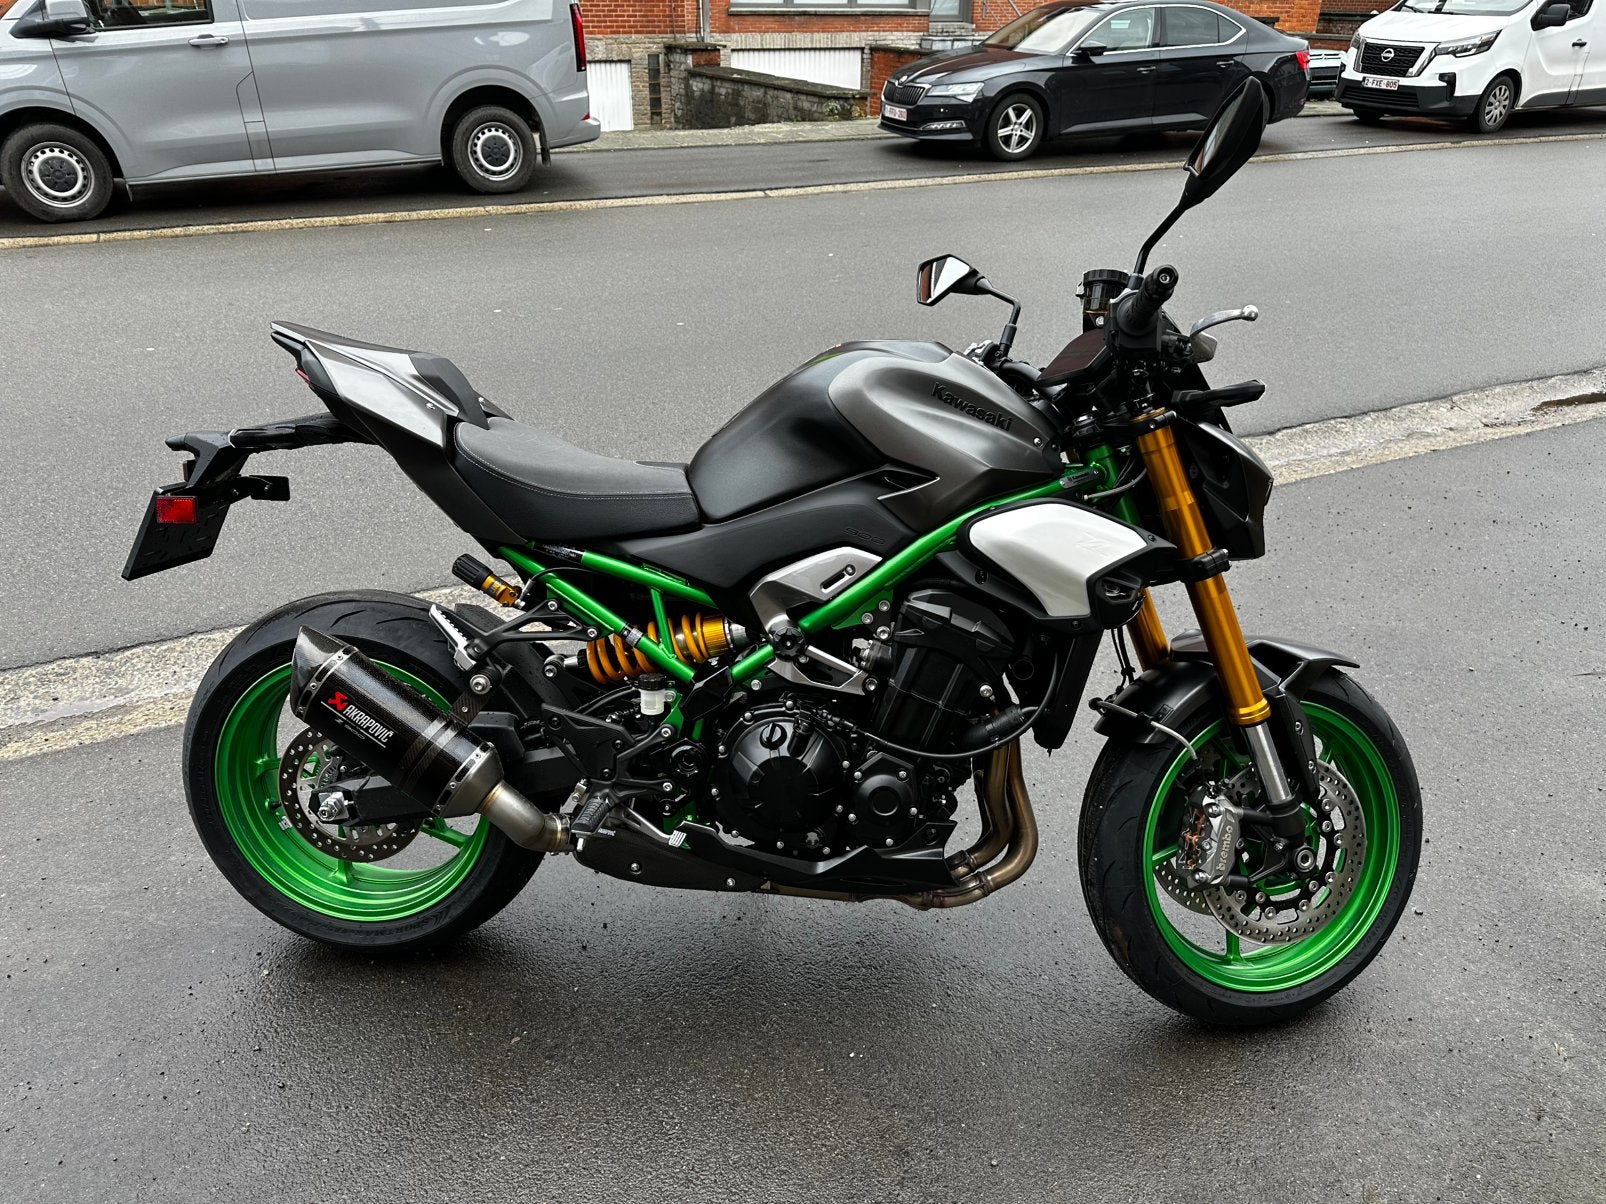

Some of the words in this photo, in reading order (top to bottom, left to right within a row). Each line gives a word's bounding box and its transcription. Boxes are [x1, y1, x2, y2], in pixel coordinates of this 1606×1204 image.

[931, 381, 1013, 432] Kawasaki
[342, 704, 394, 743] AKRAPOVIČ
[1216, 825, 1234, 871] brembo
